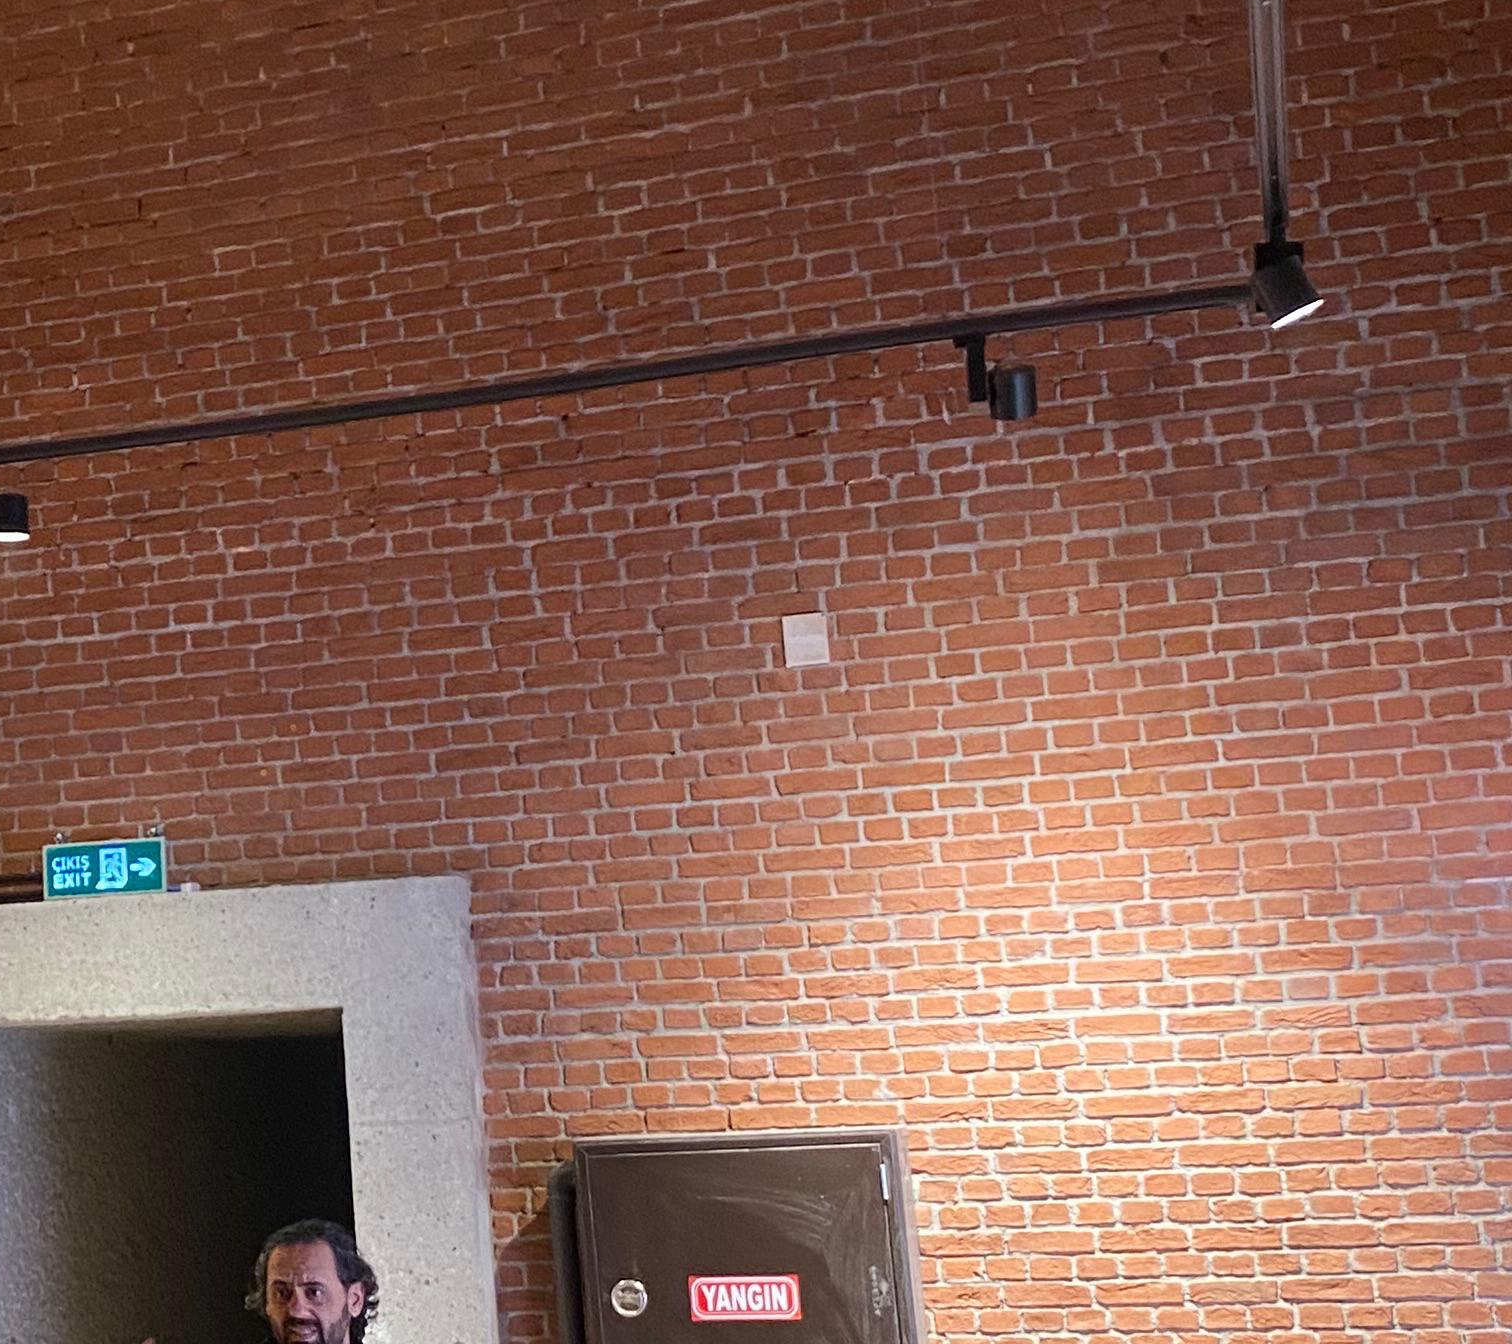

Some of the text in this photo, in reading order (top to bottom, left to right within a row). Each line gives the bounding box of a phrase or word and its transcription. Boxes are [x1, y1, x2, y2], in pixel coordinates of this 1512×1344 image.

[51, 855, 90, 872] ÇIKIŞ
[53, 872, 92, 889] EXIT
[700, 1283, 789, 1312] YANGIN
